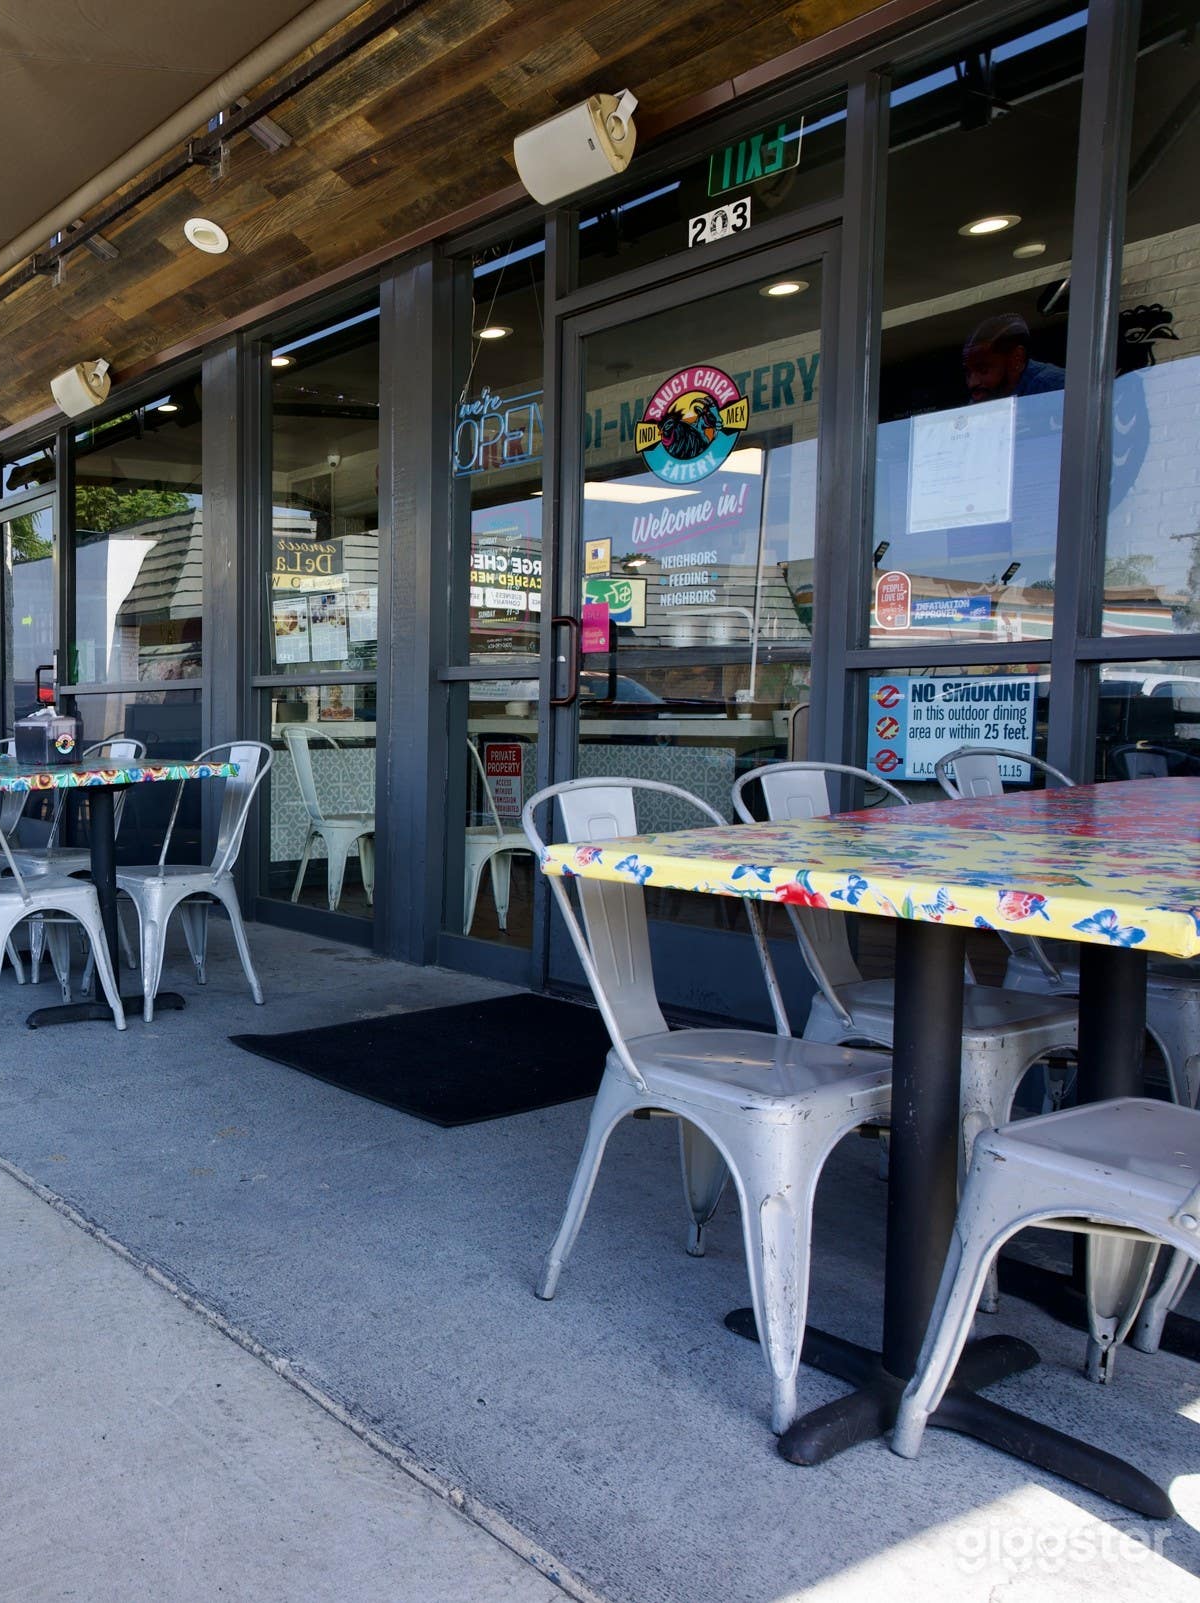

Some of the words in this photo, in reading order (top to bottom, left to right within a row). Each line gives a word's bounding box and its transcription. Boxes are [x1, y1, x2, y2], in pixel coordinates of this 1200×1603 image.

[691, 201, 748, 247] 203
[732, 352, 820, 413] TERY
[649, 373, 689, 418] SAUCY
[693, 370, 735, 404] CHICK
[639, 426, 657, 444] INDI
[726, 405, 746, 425] MEX
[661, 451, 717, 480] EATERY
[631, 500, 714, 545] Welcome
[717, 483, 749, 518] in!
[661, 550, 718, 569] NEIGHBORS
[669, 571, 709, 587] FEEDING
[660, 589, 717, 606] NEIGHBORS
[915, 600, 970, 611] INFATUATION
[914, 608, 958, 619] APPROVED
[911, 683, 936, 703] NO
[942, 682, 1031, 703] SMOKING
[913, 706, 922, 721] in
[926, 706, 945, 721] this
[949, 706, 990, 721] outdoor
[993, 705, 1027, 724] dining
[908, 728, 931, 739] area
[935, 728, 946, 739] or
[949, 725, 980, 739] within
[984, 724, 999, 739] 25
[1003, 723, 1029, 740] feet.
[490, 750, 516, 761] PRIVATE
[487, 762, 520, 773] PROPERTY
